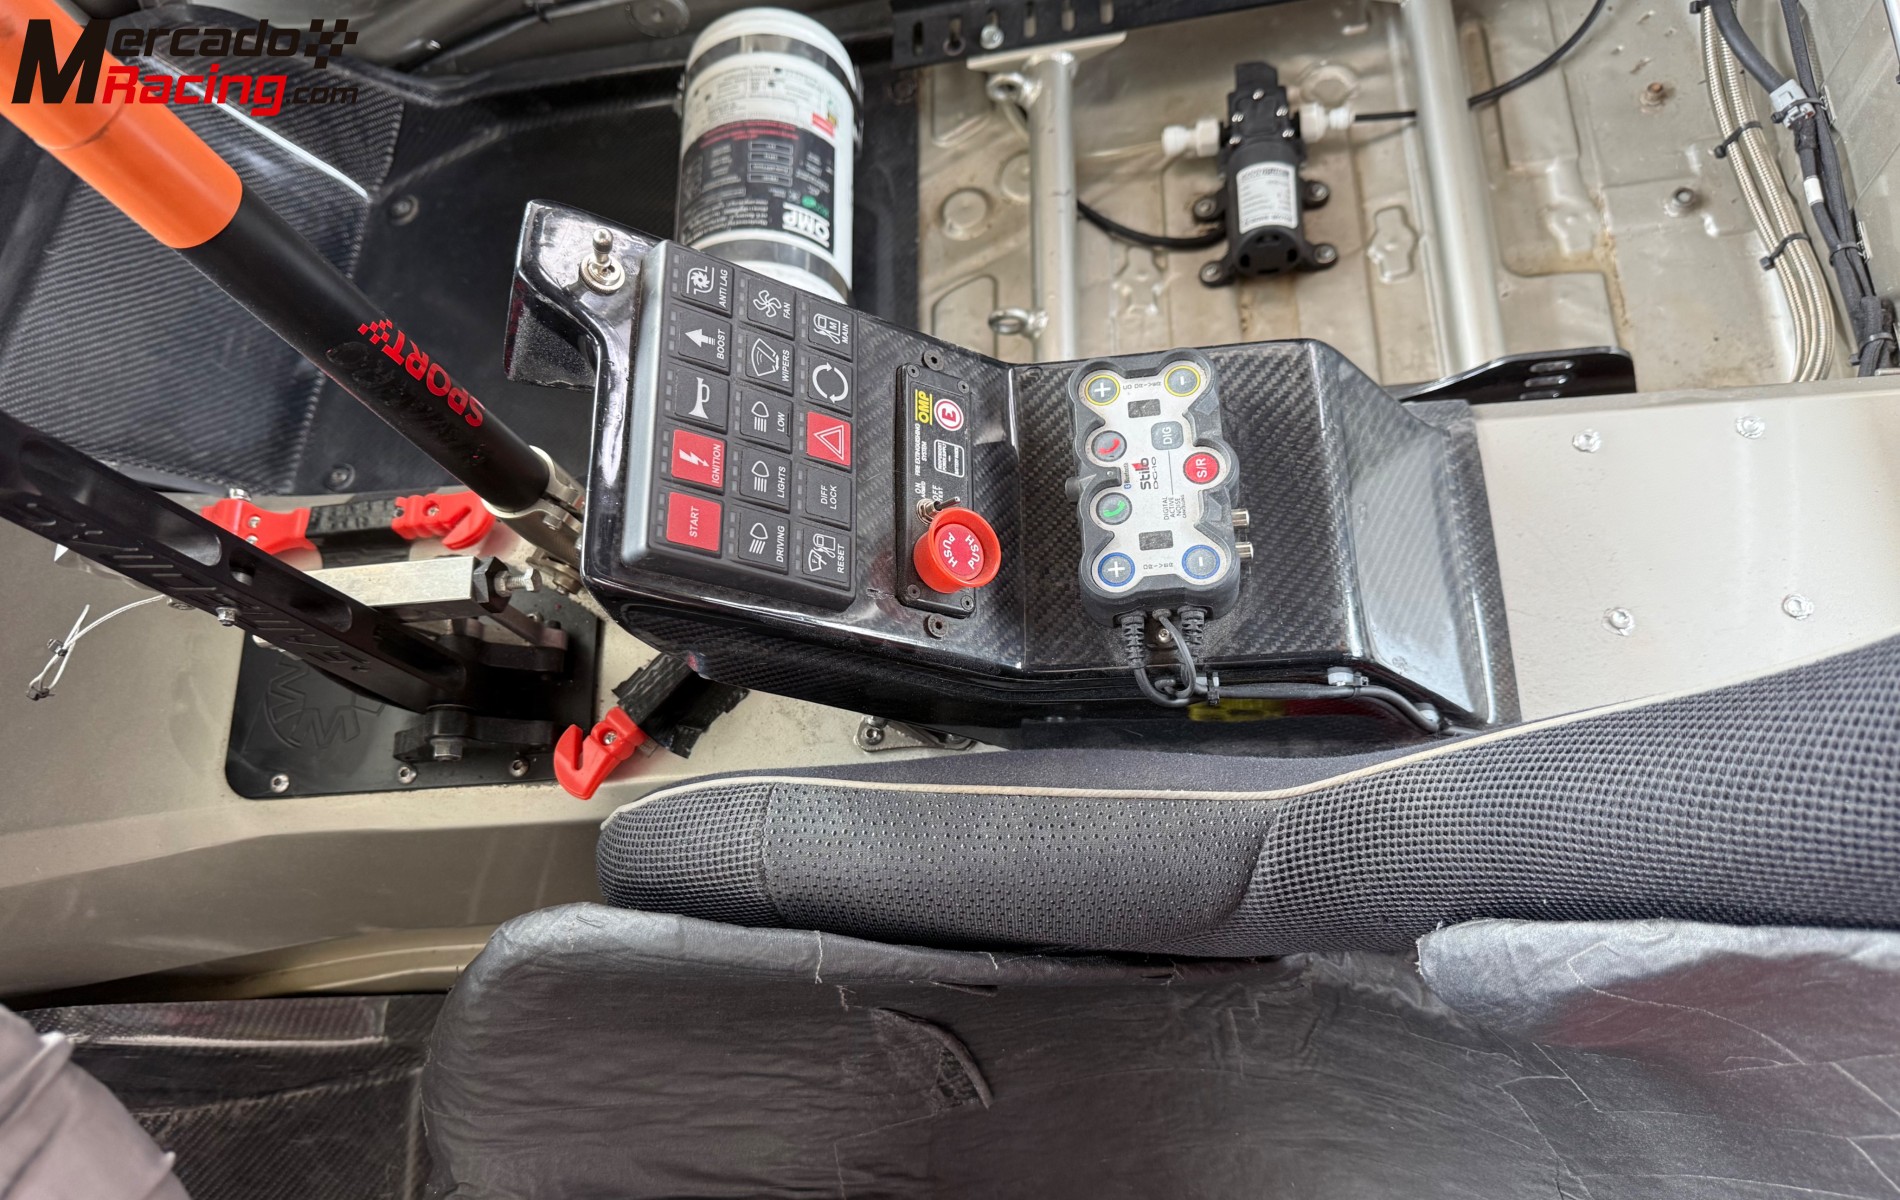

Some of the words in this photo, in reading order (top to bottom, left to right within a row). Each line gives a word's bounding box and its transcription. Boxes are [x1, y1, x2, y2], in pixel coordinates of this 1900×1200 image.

[783, 209, 829, 239] OMP
[719, 269, 728, 284] LAG
[718, 284, 727, 308] ANTI
[783, 302, 791, 319] FAN
[717, 329, 726, 360] BOOST
[381, 329, 485, 427] SPORT
[782, 350, 790, 382] WIPERS
[777, 412, 786, 432] LOW
[918, 390, 930, 424] OMP
[942, 408, 957, 422] E
[1162, 426, 1172, 445] DIG
[712, 443, 721, 484] IGNITION
[1135, 457, 1151, 490] Stilo
[1196, 457, 1208, 478] S/R
[777, 466, 786, 499] LIGHTS
[914, 482, 921, 494] ON
[689, 506, 699, 538] START
[776, 525, 785, 563] DRIVING
[837, 544, 845, 573] RESET
[943, 532, 957, 568] PUSH
[965, 534, 981, 570] PUSH
